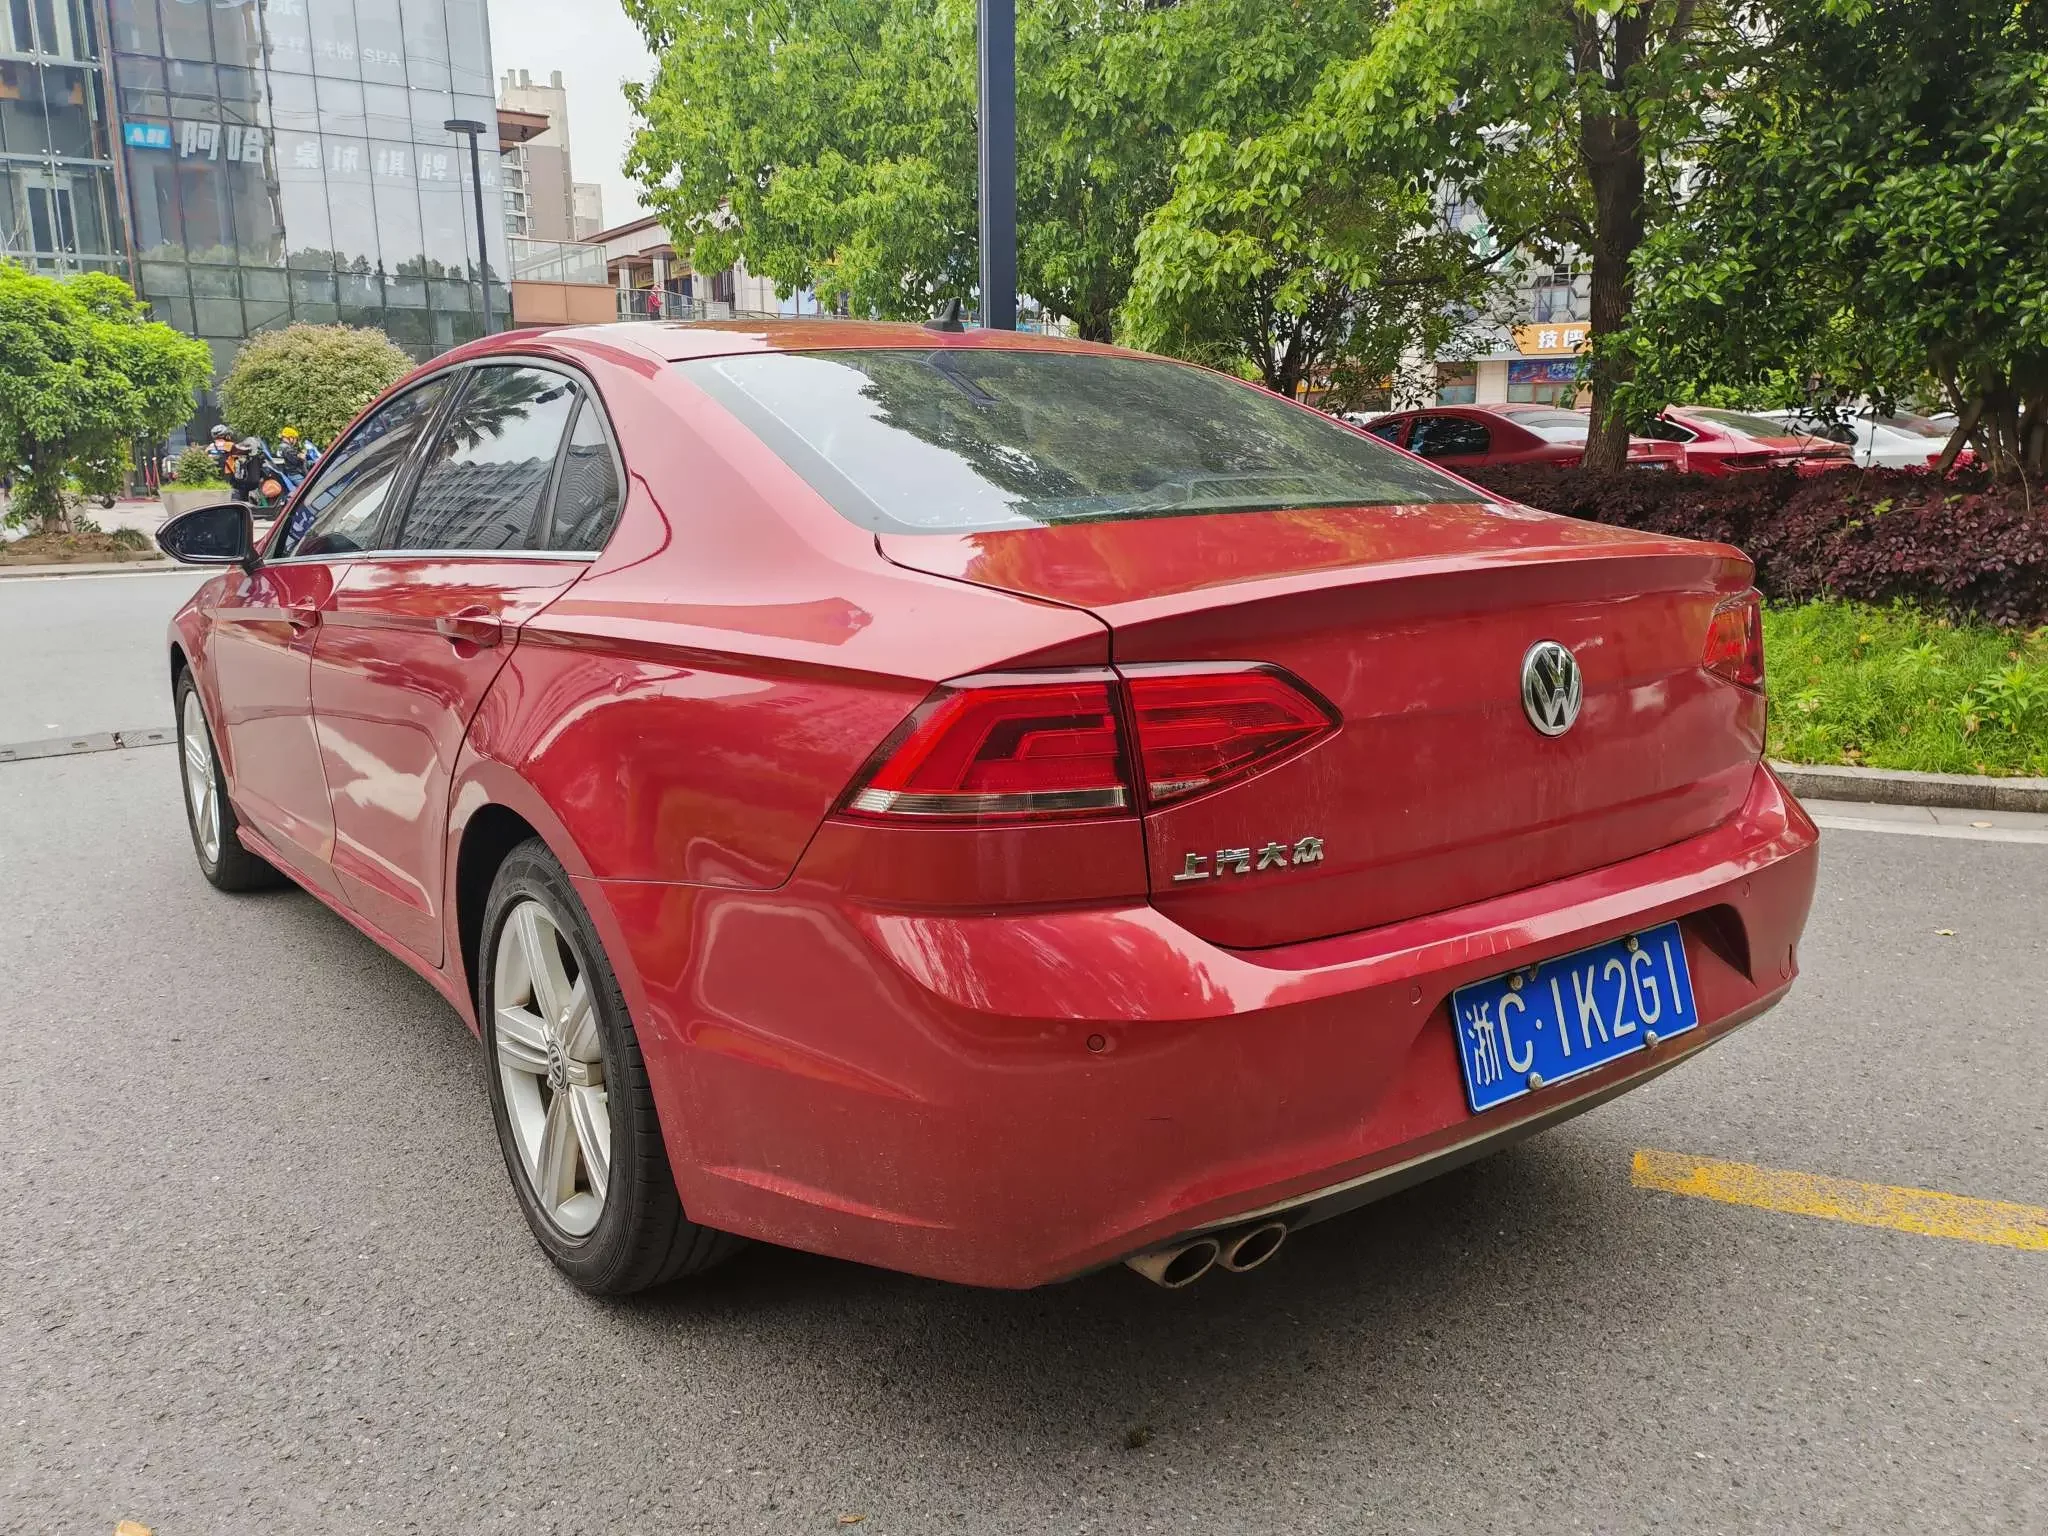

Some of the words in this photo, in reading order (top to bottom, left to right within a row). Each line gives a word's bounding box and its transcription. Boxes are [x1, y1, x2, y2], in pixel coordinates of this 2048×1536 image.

[181, 121, 266, 163] 阿哈
[1173, 836, 1325, 881] 上汽大众
